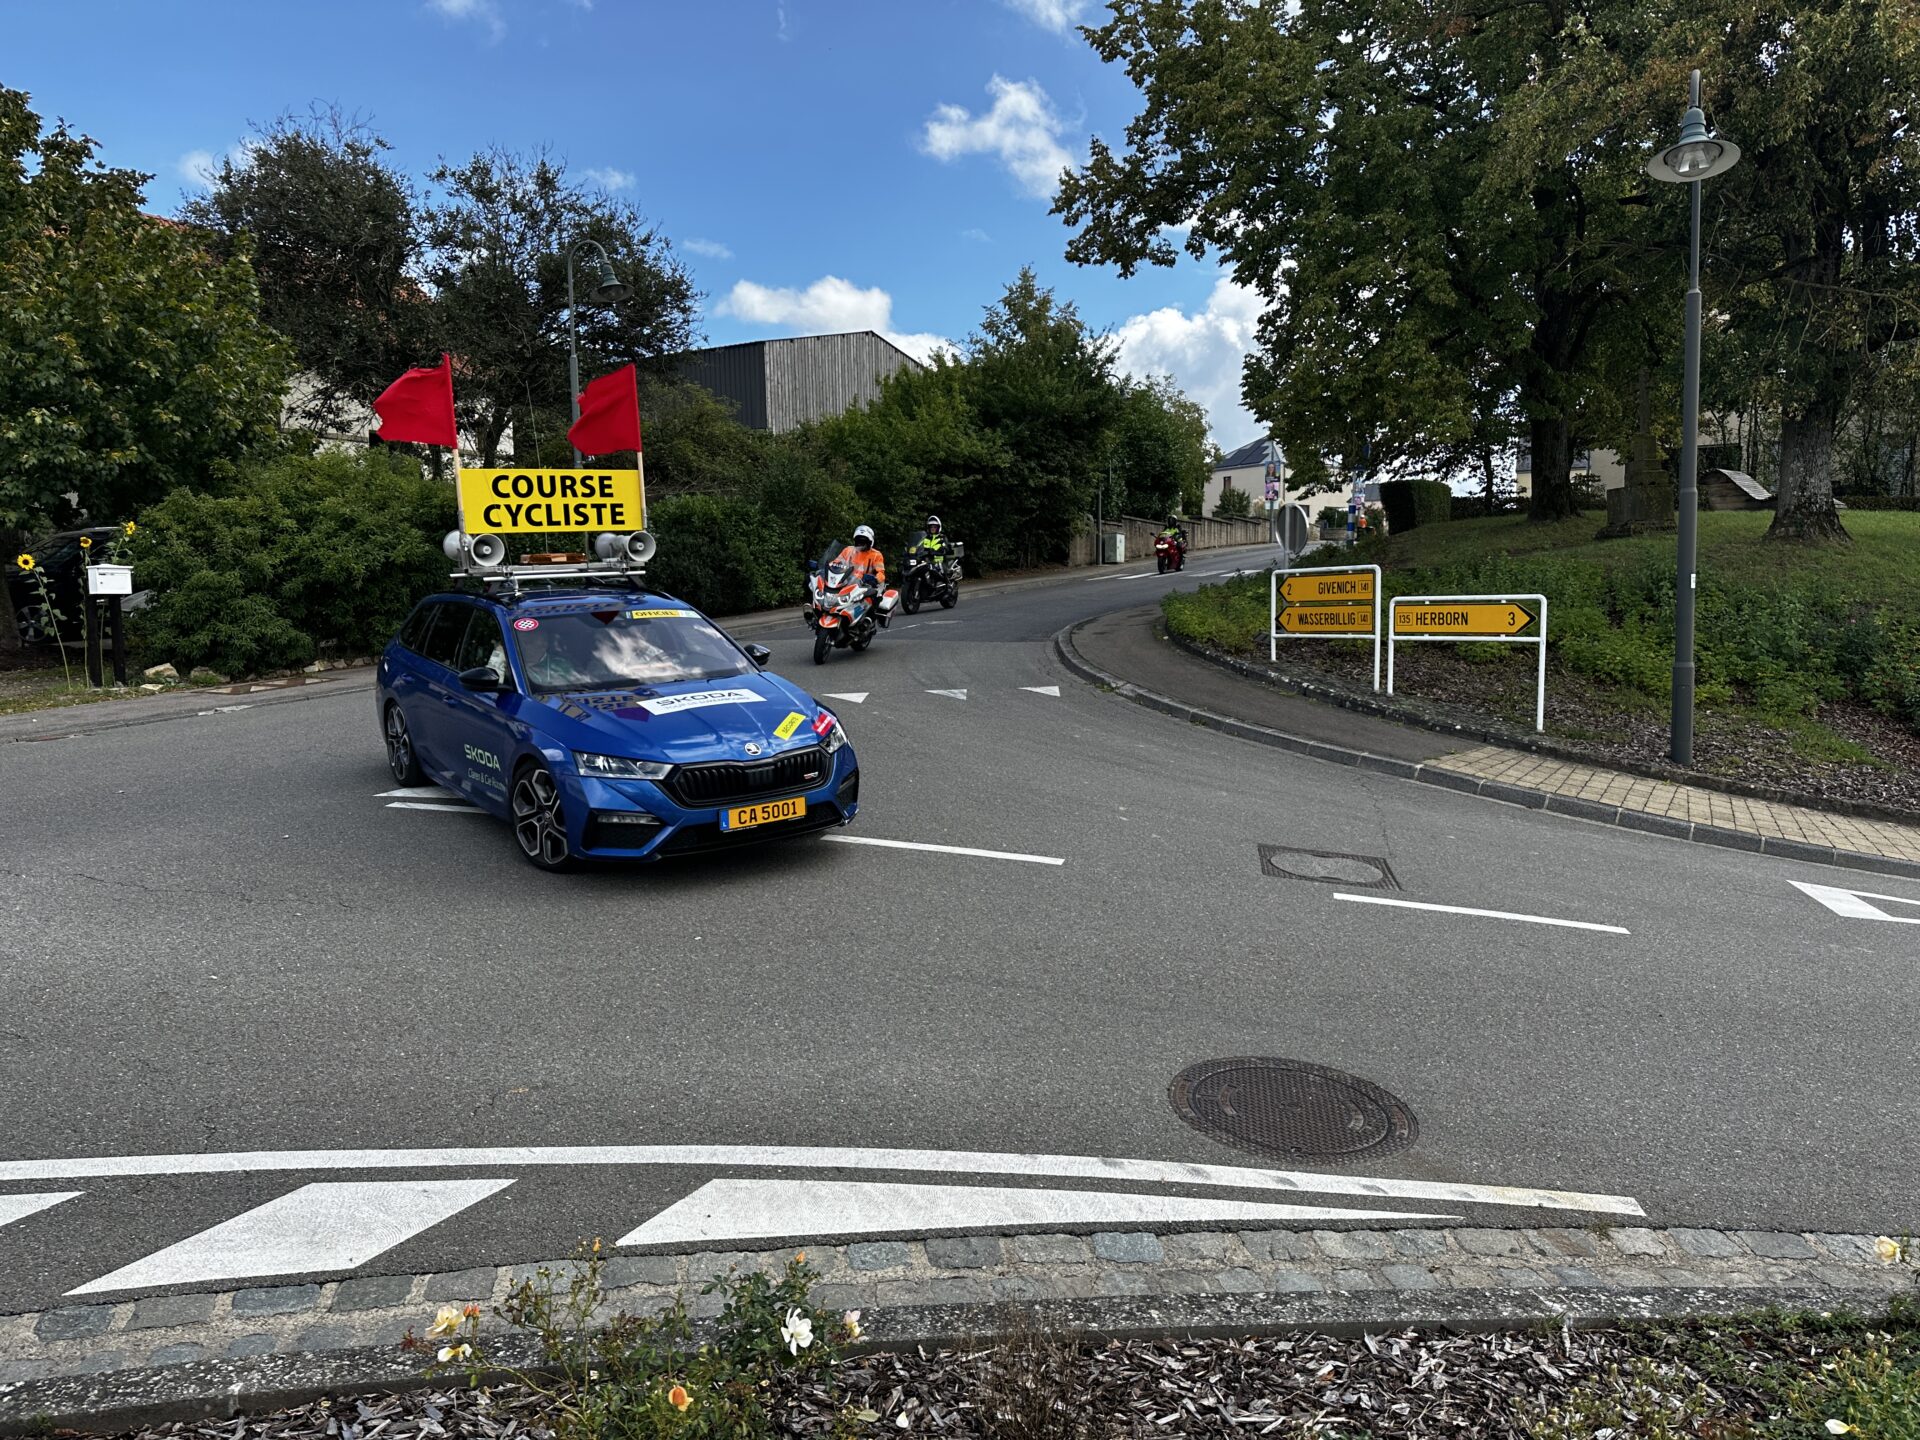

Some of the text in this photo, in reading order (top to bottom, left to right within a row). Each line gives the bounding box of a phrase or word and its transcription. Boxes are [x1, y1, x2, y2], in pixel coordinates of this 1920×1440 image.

[492, 475, 614, 498] COURSE
[483, 503, 625, 527] CYCLISTE
[1287, 581, 1369, 595] 2 GIVENICH 141
[1286, 612, 1369, 626] 7 WASSERBILLIG 141
[1398, 612, 1516, 626] 135 HERBORN 3
[738, 801, 797, 824] CA 5001
